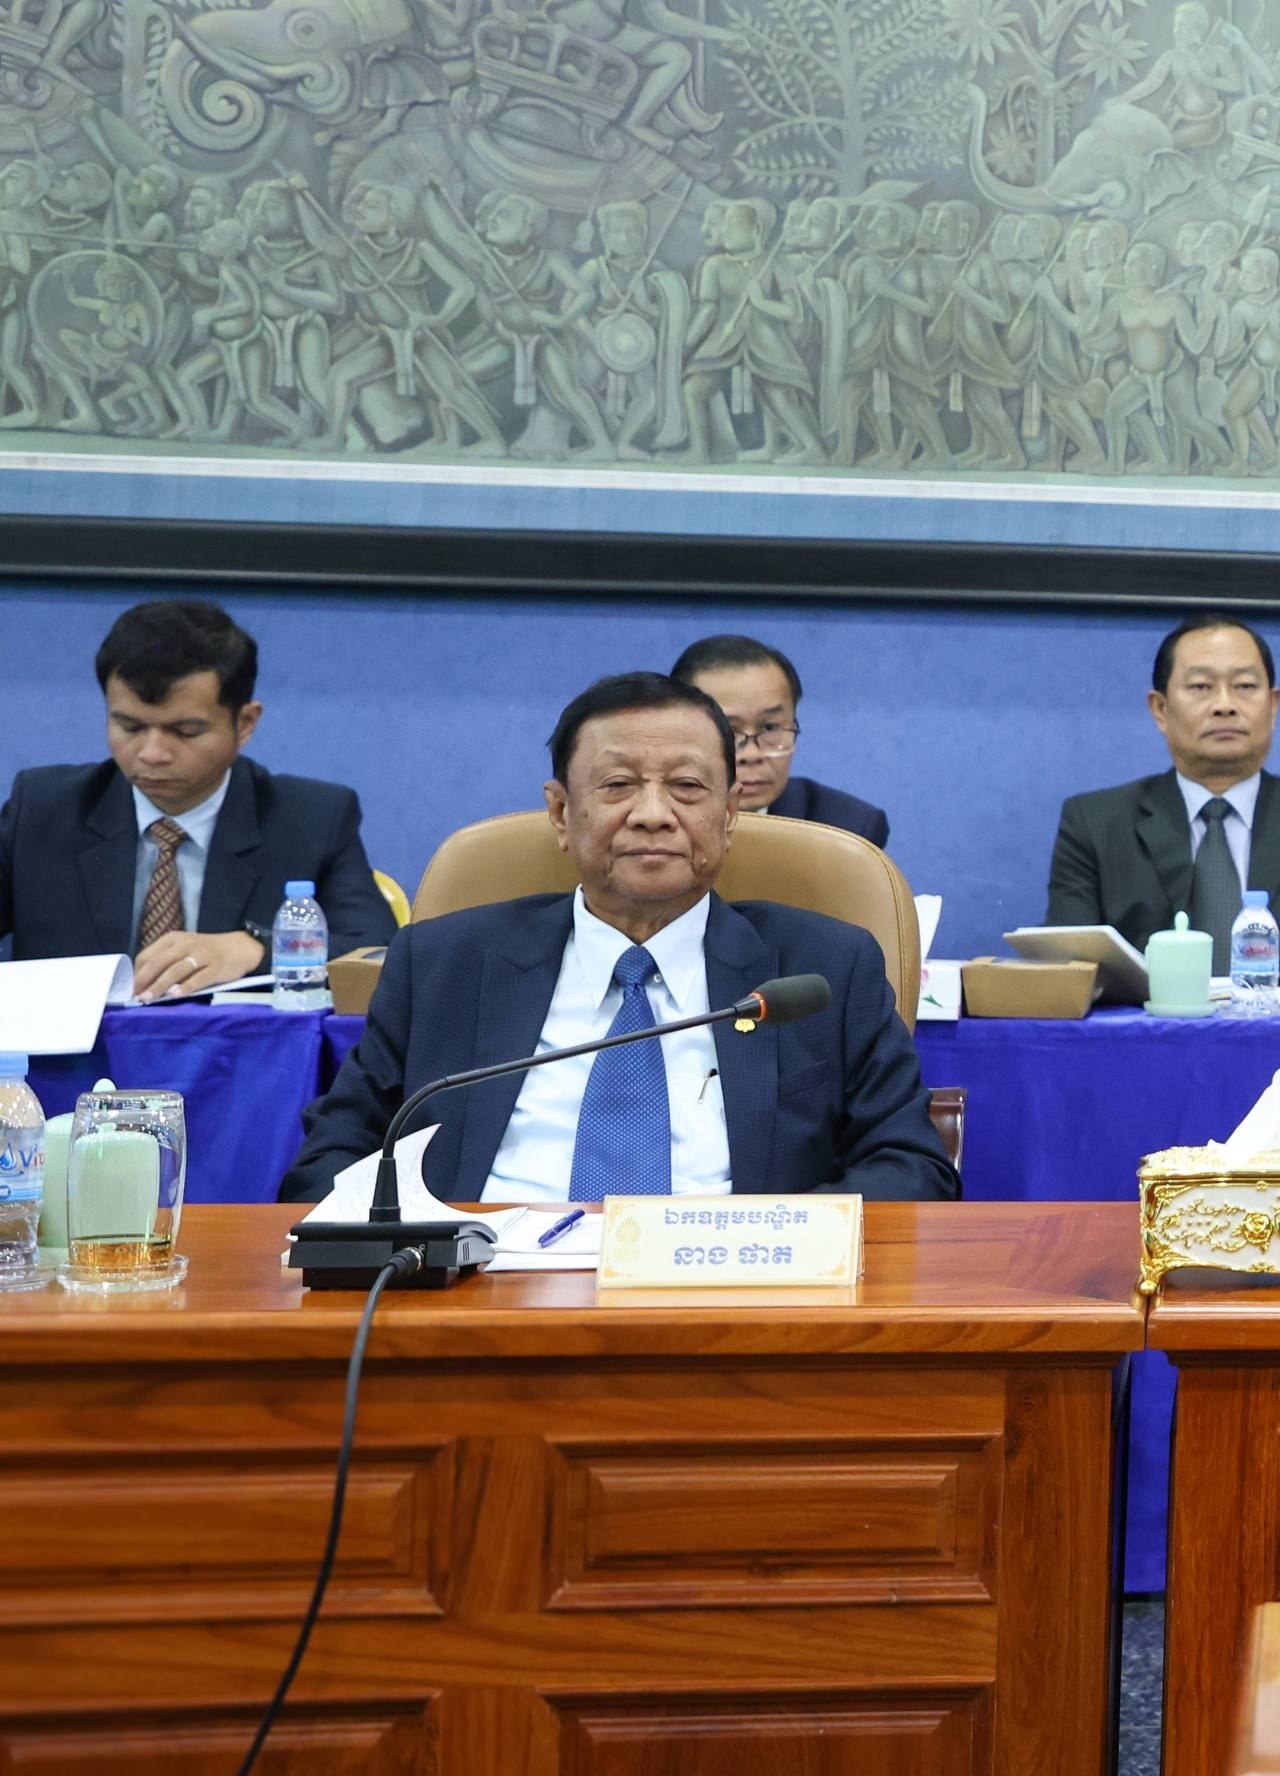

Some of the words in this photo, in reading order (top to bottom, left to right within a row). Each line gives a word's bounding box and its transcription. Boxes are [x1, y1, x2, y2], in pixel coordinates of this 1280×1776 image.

[664, 1204, 809, 1230] ឯកឧត្តមបណ្ឌិត
[673, 1246, 728, 1265] នាង
[738, 1243, 793, 1265] ផាត
